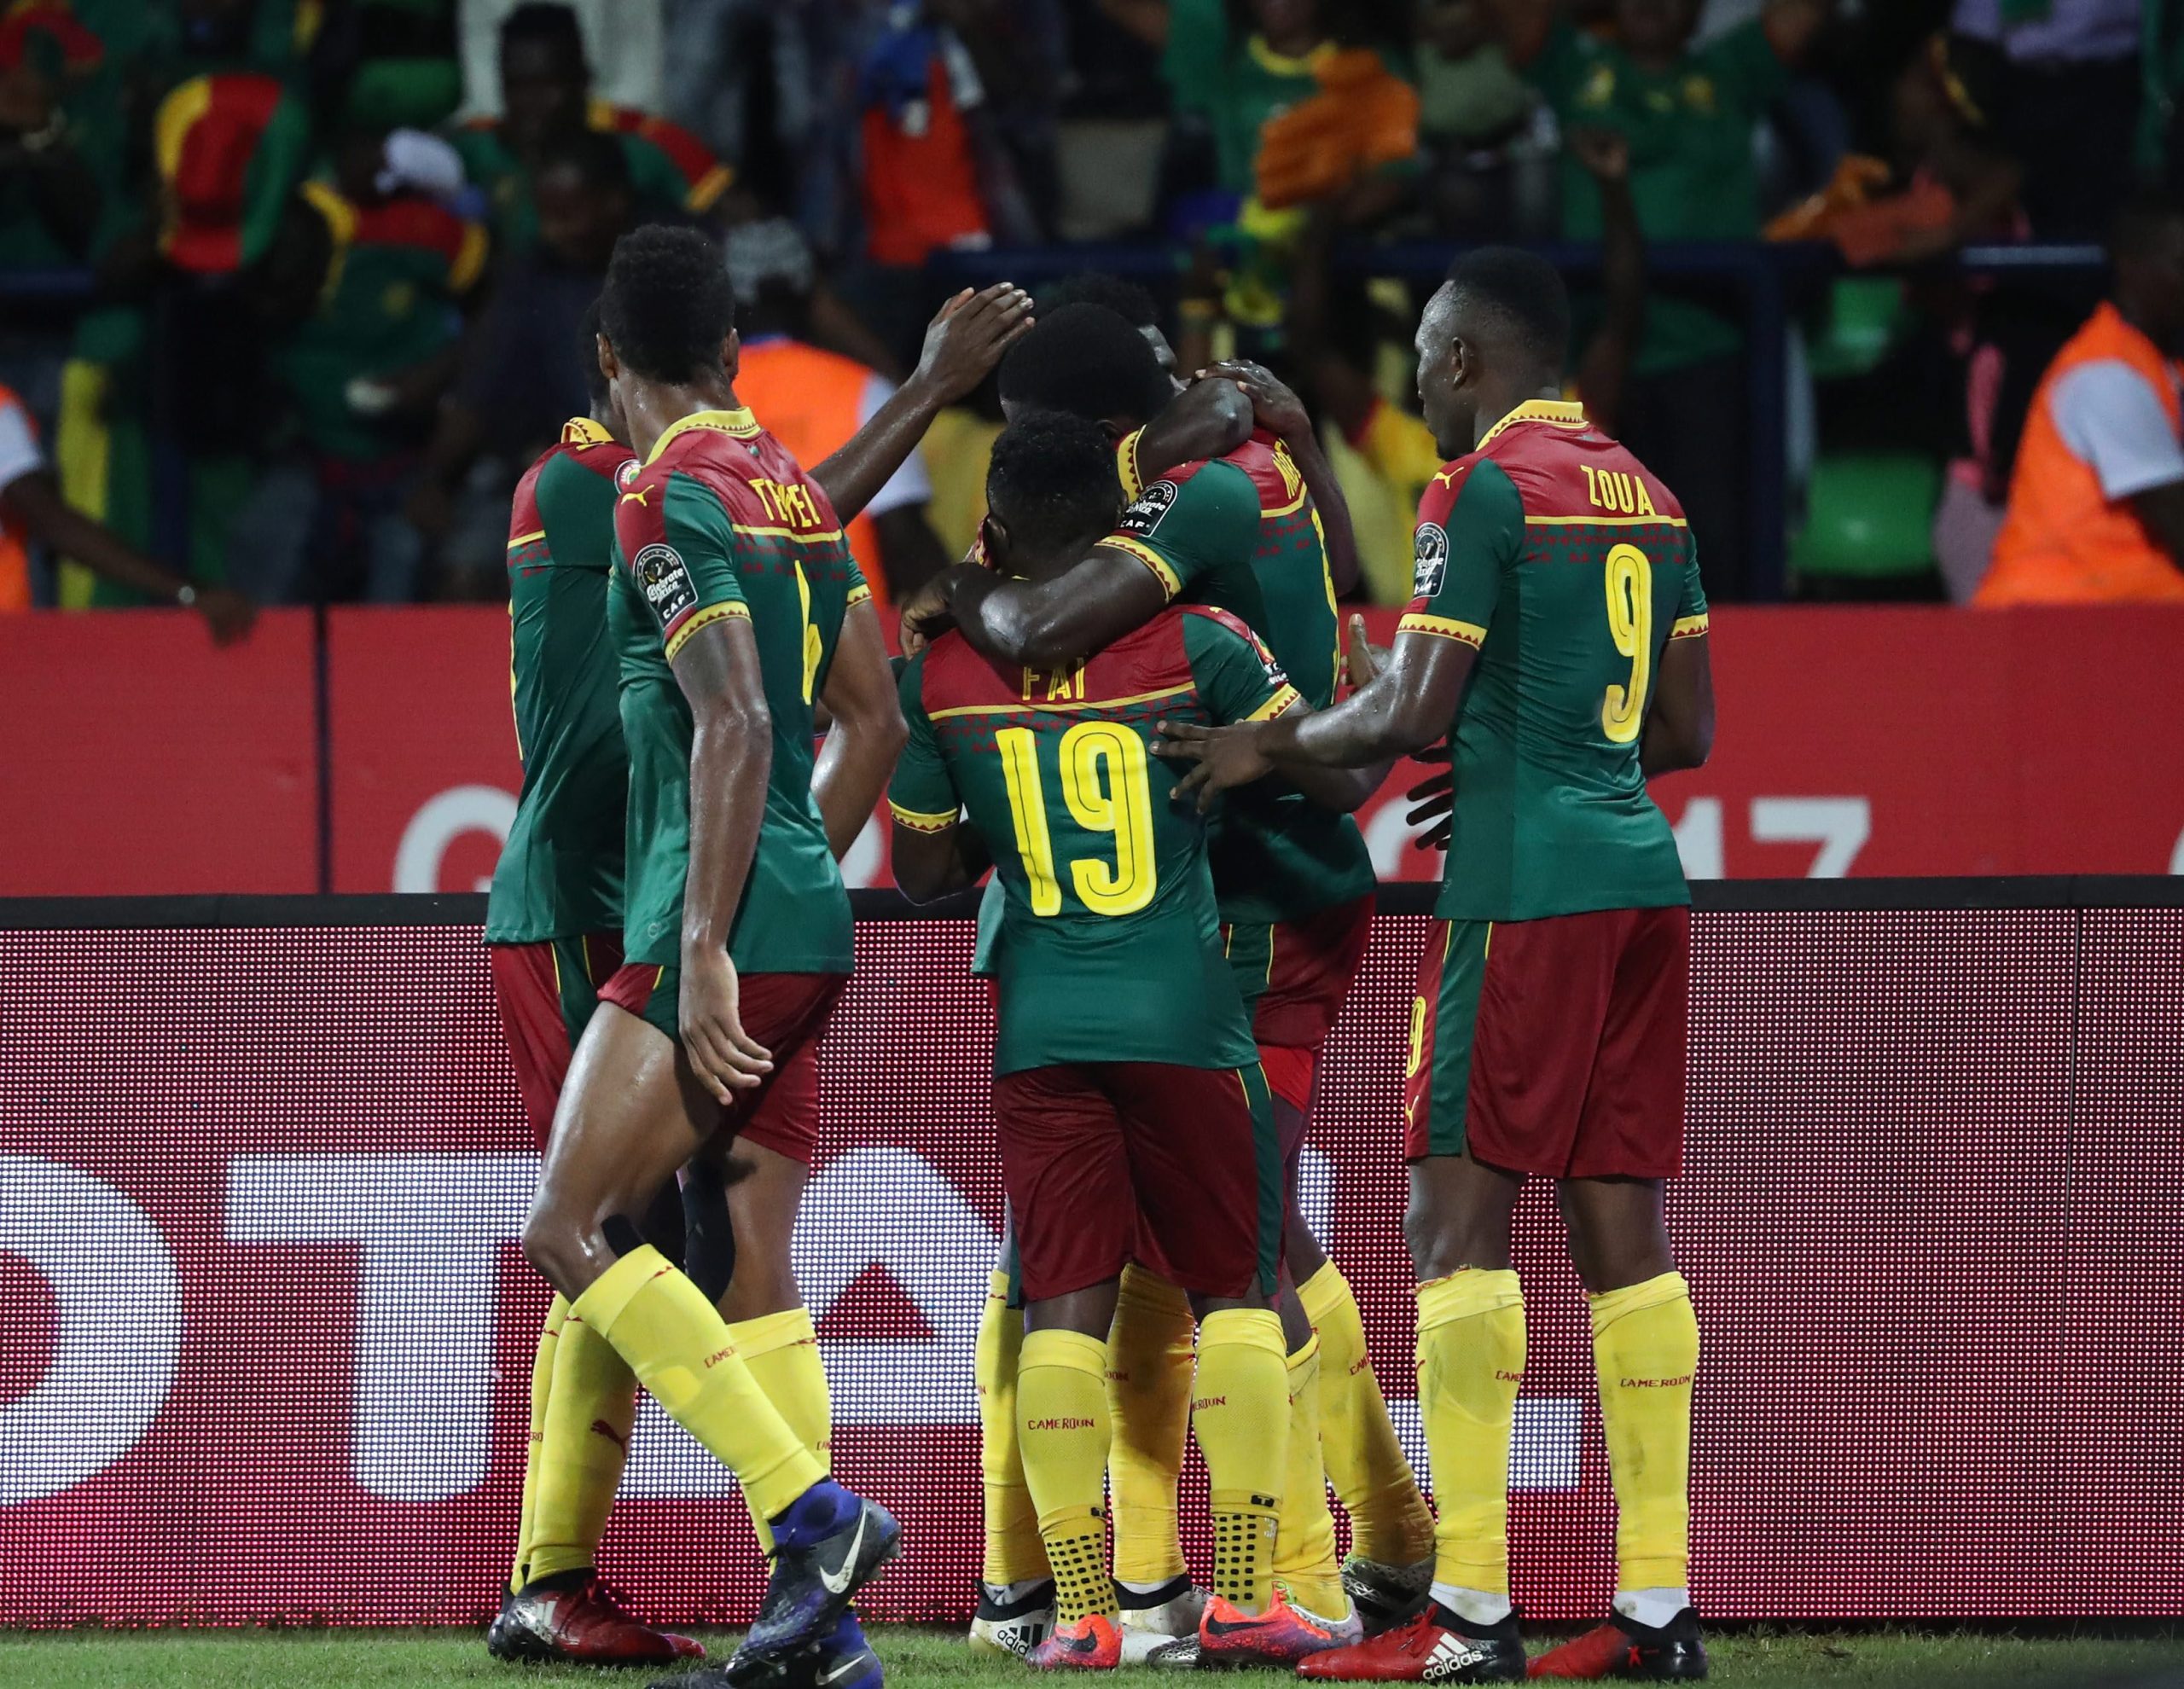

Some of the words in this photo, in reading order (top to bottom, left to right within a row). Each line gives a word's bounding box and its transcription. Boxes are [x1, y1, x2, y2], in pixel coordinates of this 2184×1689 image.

[1580, 464, 1656, 516] ZOUA
[662, 594, 685, 619] CAF
[1601, 543, 1653, 743] 9
[1022, 657, 1085, 701] FAI
[995, 721, 1157, 917] 19
[997, 1630, 1030, 1656] adid
[1422, 1651, 1484, 1680] adidas
